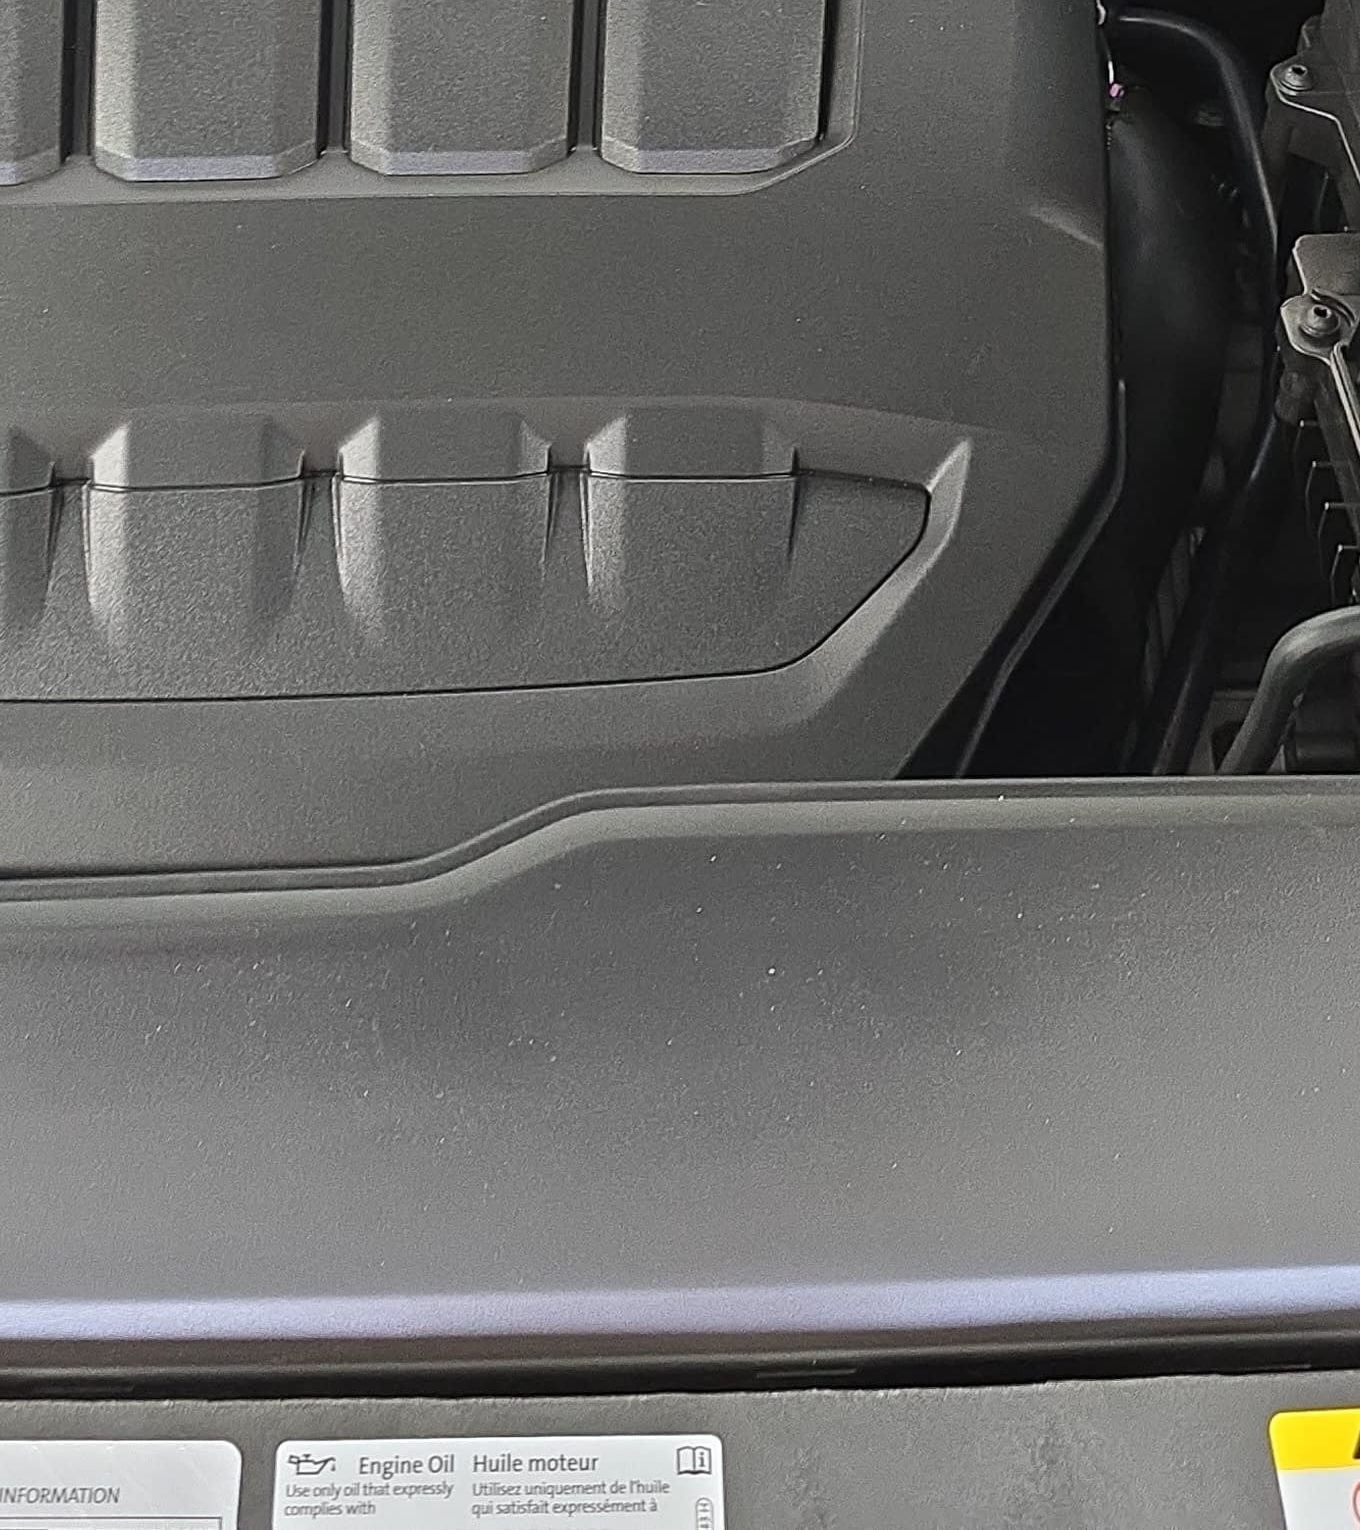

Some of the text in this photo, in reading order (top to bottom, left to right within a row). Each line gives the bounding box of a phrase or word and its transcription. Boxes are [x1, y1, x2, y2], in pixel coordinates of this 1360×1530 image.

[359, 1453, 599, 1480] Engine Oil Huile moteur
[285, 1481, 456, 1501] Use only oil that expressly
[472, 1482, 521, 1497] Utilisez
[524, 1480, 607, 1498] uniquement
[609, 1480, 628, 1495] de
[284, 1501, 376, 1519] complies with
[471, 1499, 658, 1519] qui satisfait expressément à
